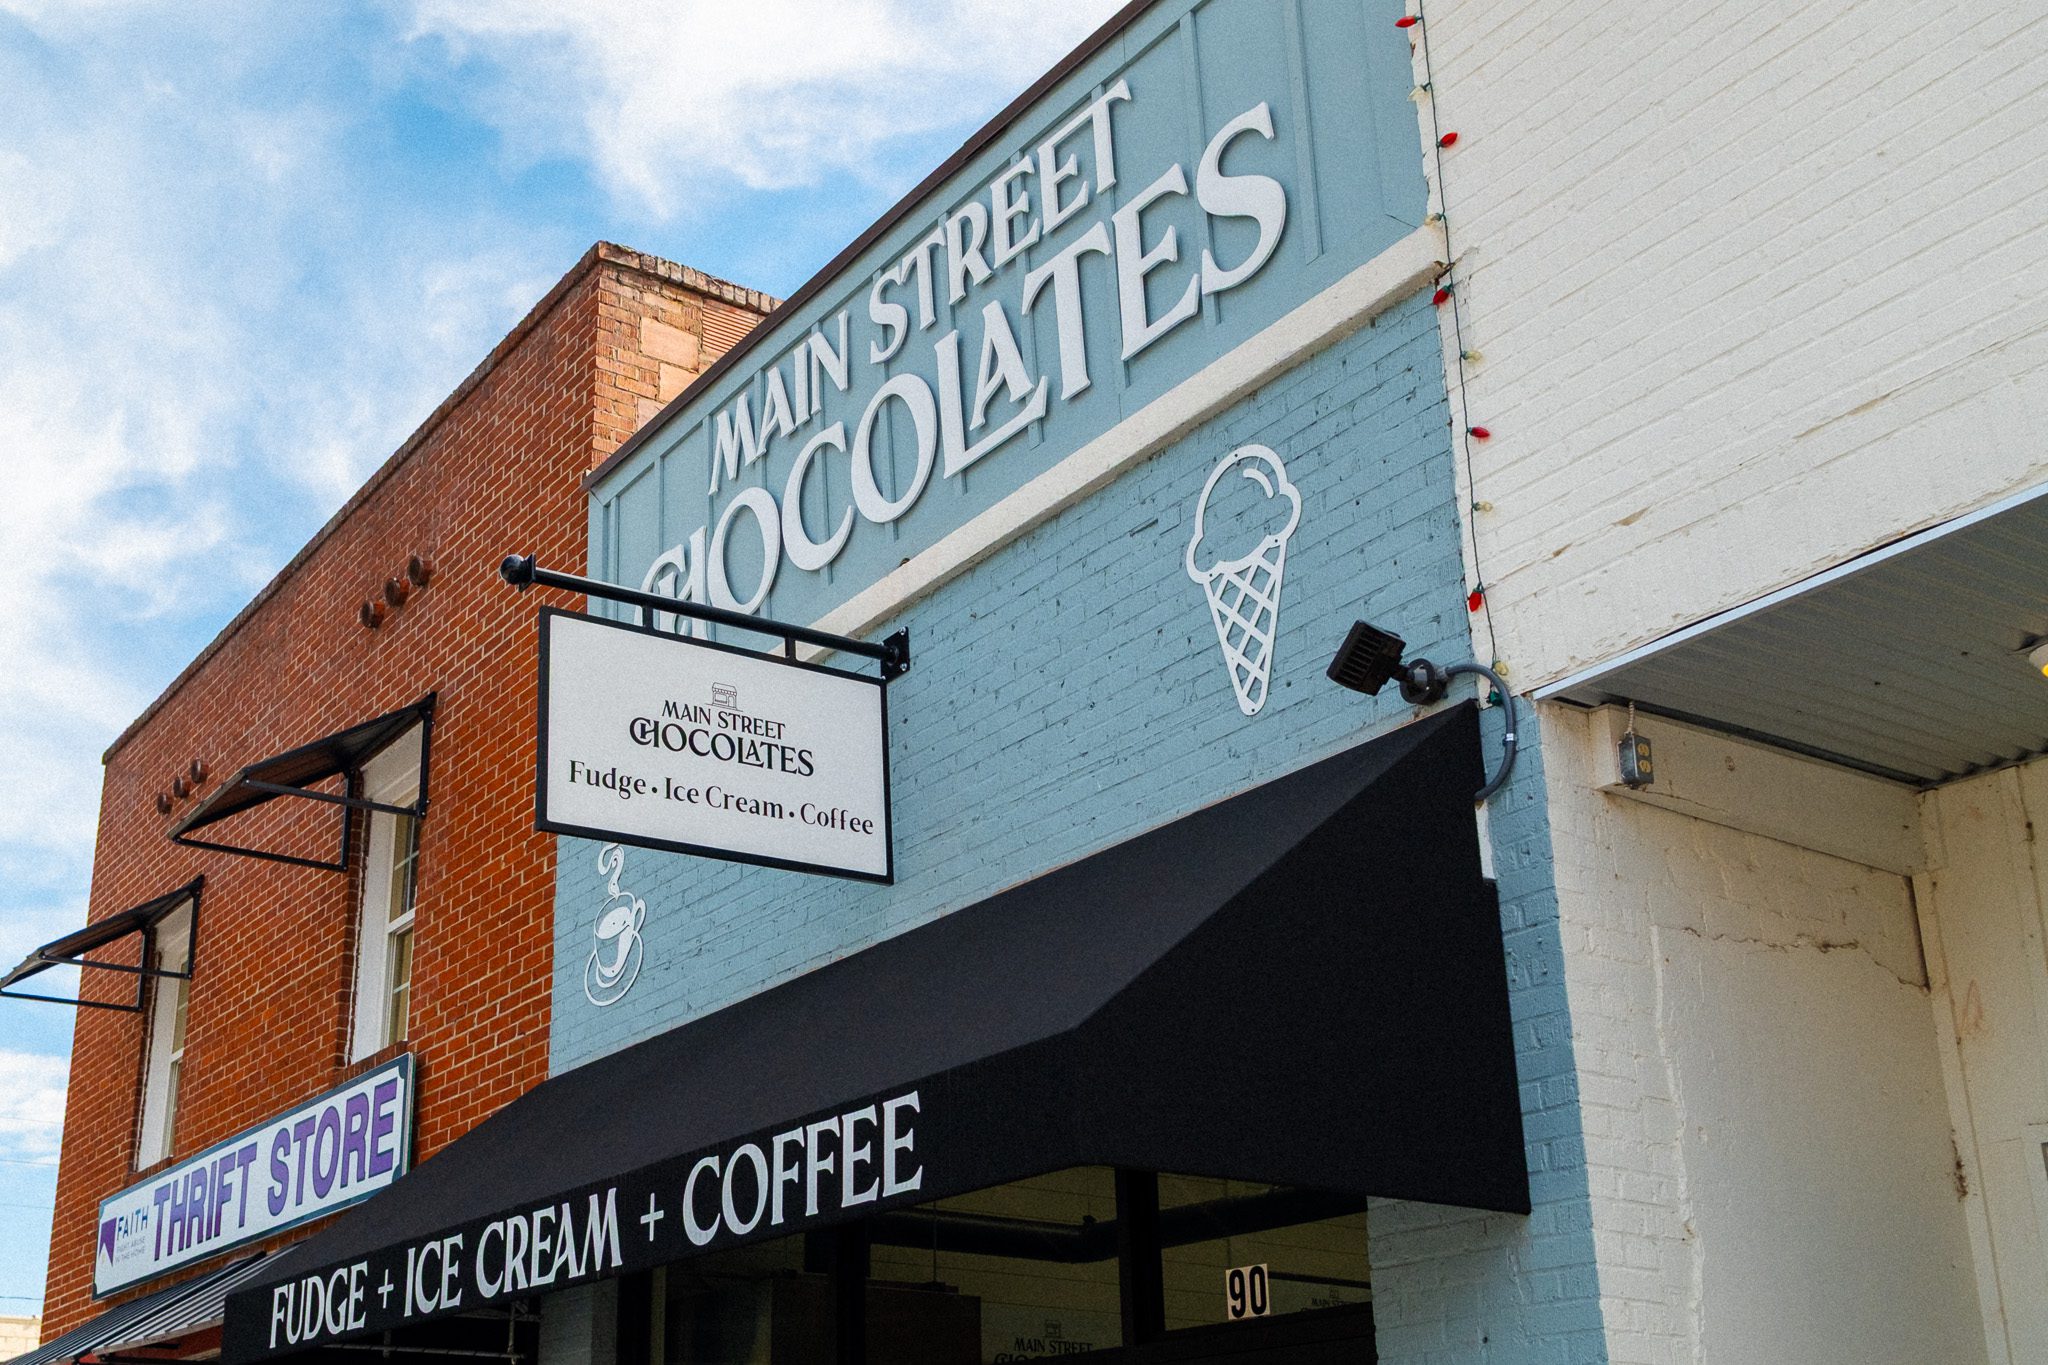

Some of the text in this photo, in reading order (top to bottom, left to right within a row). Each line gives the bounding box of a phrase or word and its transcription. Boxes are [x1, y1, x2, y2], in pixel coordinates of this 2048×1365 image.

[708, 80, 1132, 496] MAIN STREET
[633, 100, 1287, 641] CHOCOLATES
[629, 717, 814, 777] CHOCOLATES
[662, 700, 786, 740] MAIN STREET
[568, 760, 874, 835] Fudge Ice Cream Coffee
[153, 1077, 398, 1261] THRIFT STORE
[117, 1205, 149, 1240] FAITH
[269, 1261, 369, 1348] FUDGE
[403, 1233, 464, 1317] ICE
[475, 1187, 623, 1298] CREAM
[682, 1091, 923, 1246] COFFEE
[1228, 1265, 1268, 1318] 90
[1014, 1337, 1045, 1353] MAIN
